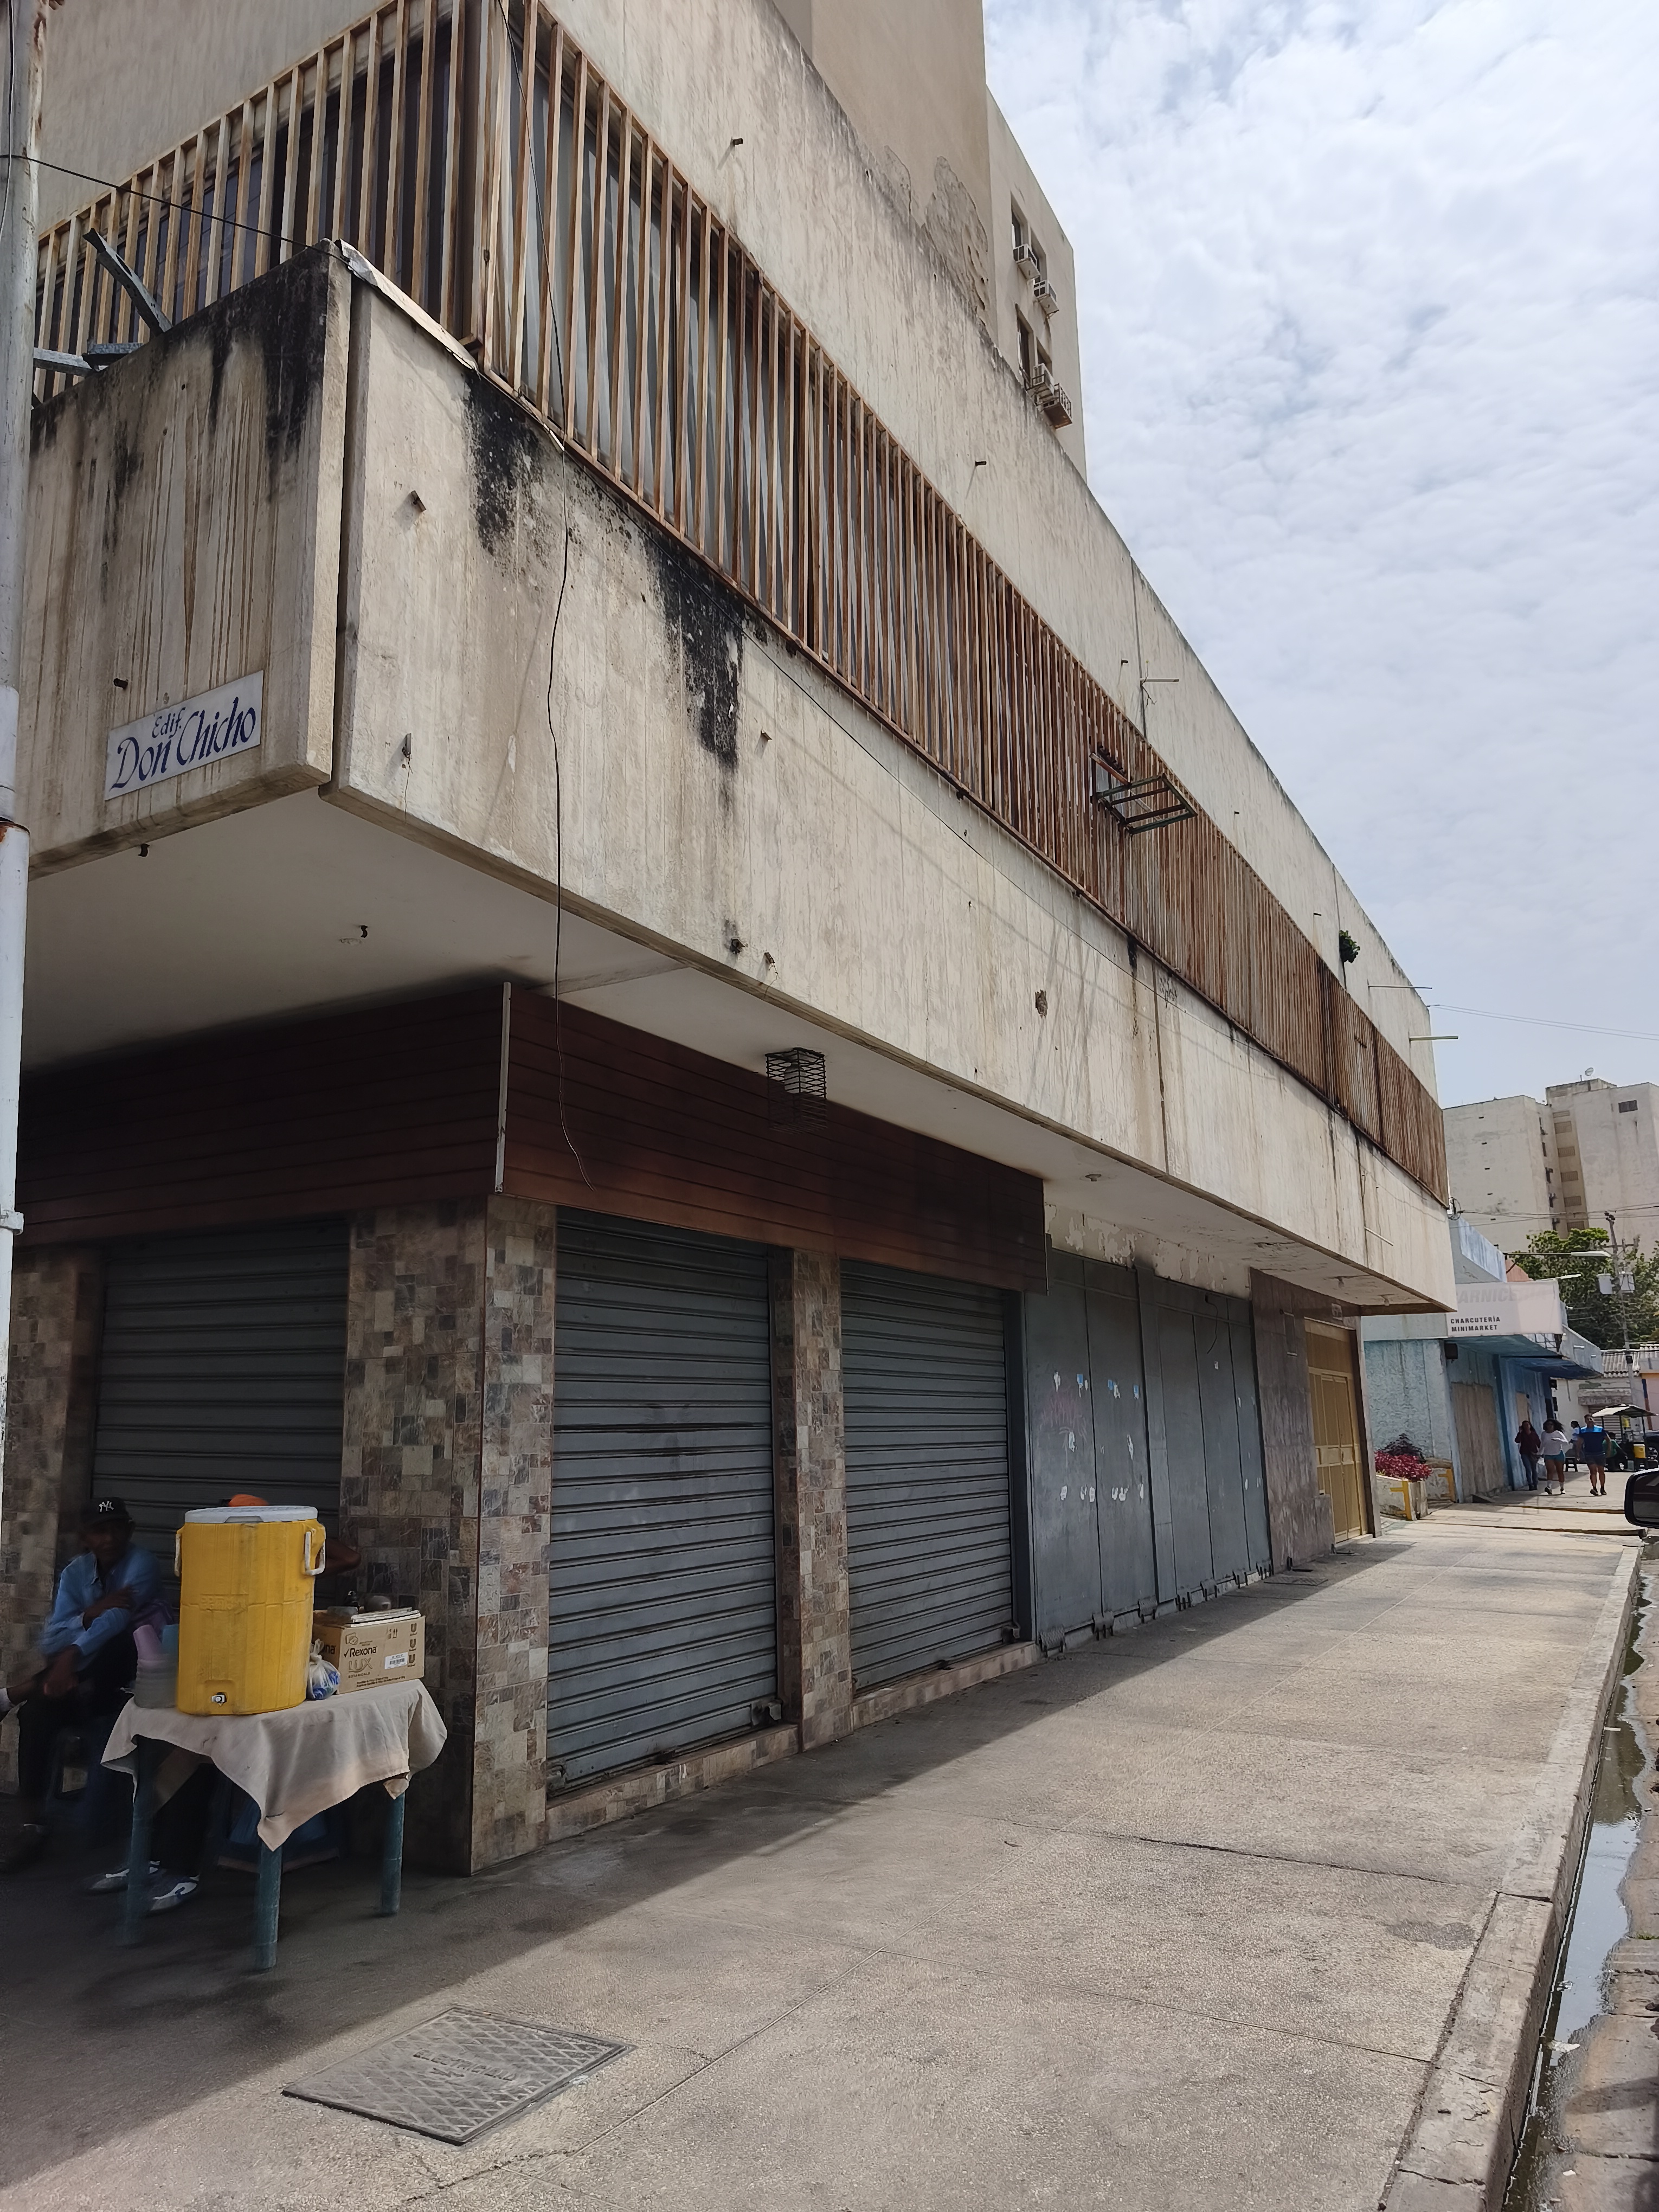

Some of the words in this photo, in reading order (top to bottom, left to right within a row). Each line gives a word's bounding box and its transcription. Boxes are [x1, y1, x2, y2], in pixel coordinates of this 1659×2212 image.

[152, 707, 186, 738] Edif.
[109, 735, 172, 792] Don
[176, 696, 256, 766] Chicho
[1450, 1315, 1501, 1324] CHARCUTERÍA
[350, 1647, 377, 1657] Rexona
[348, 1657, 373, 1673] LUX
